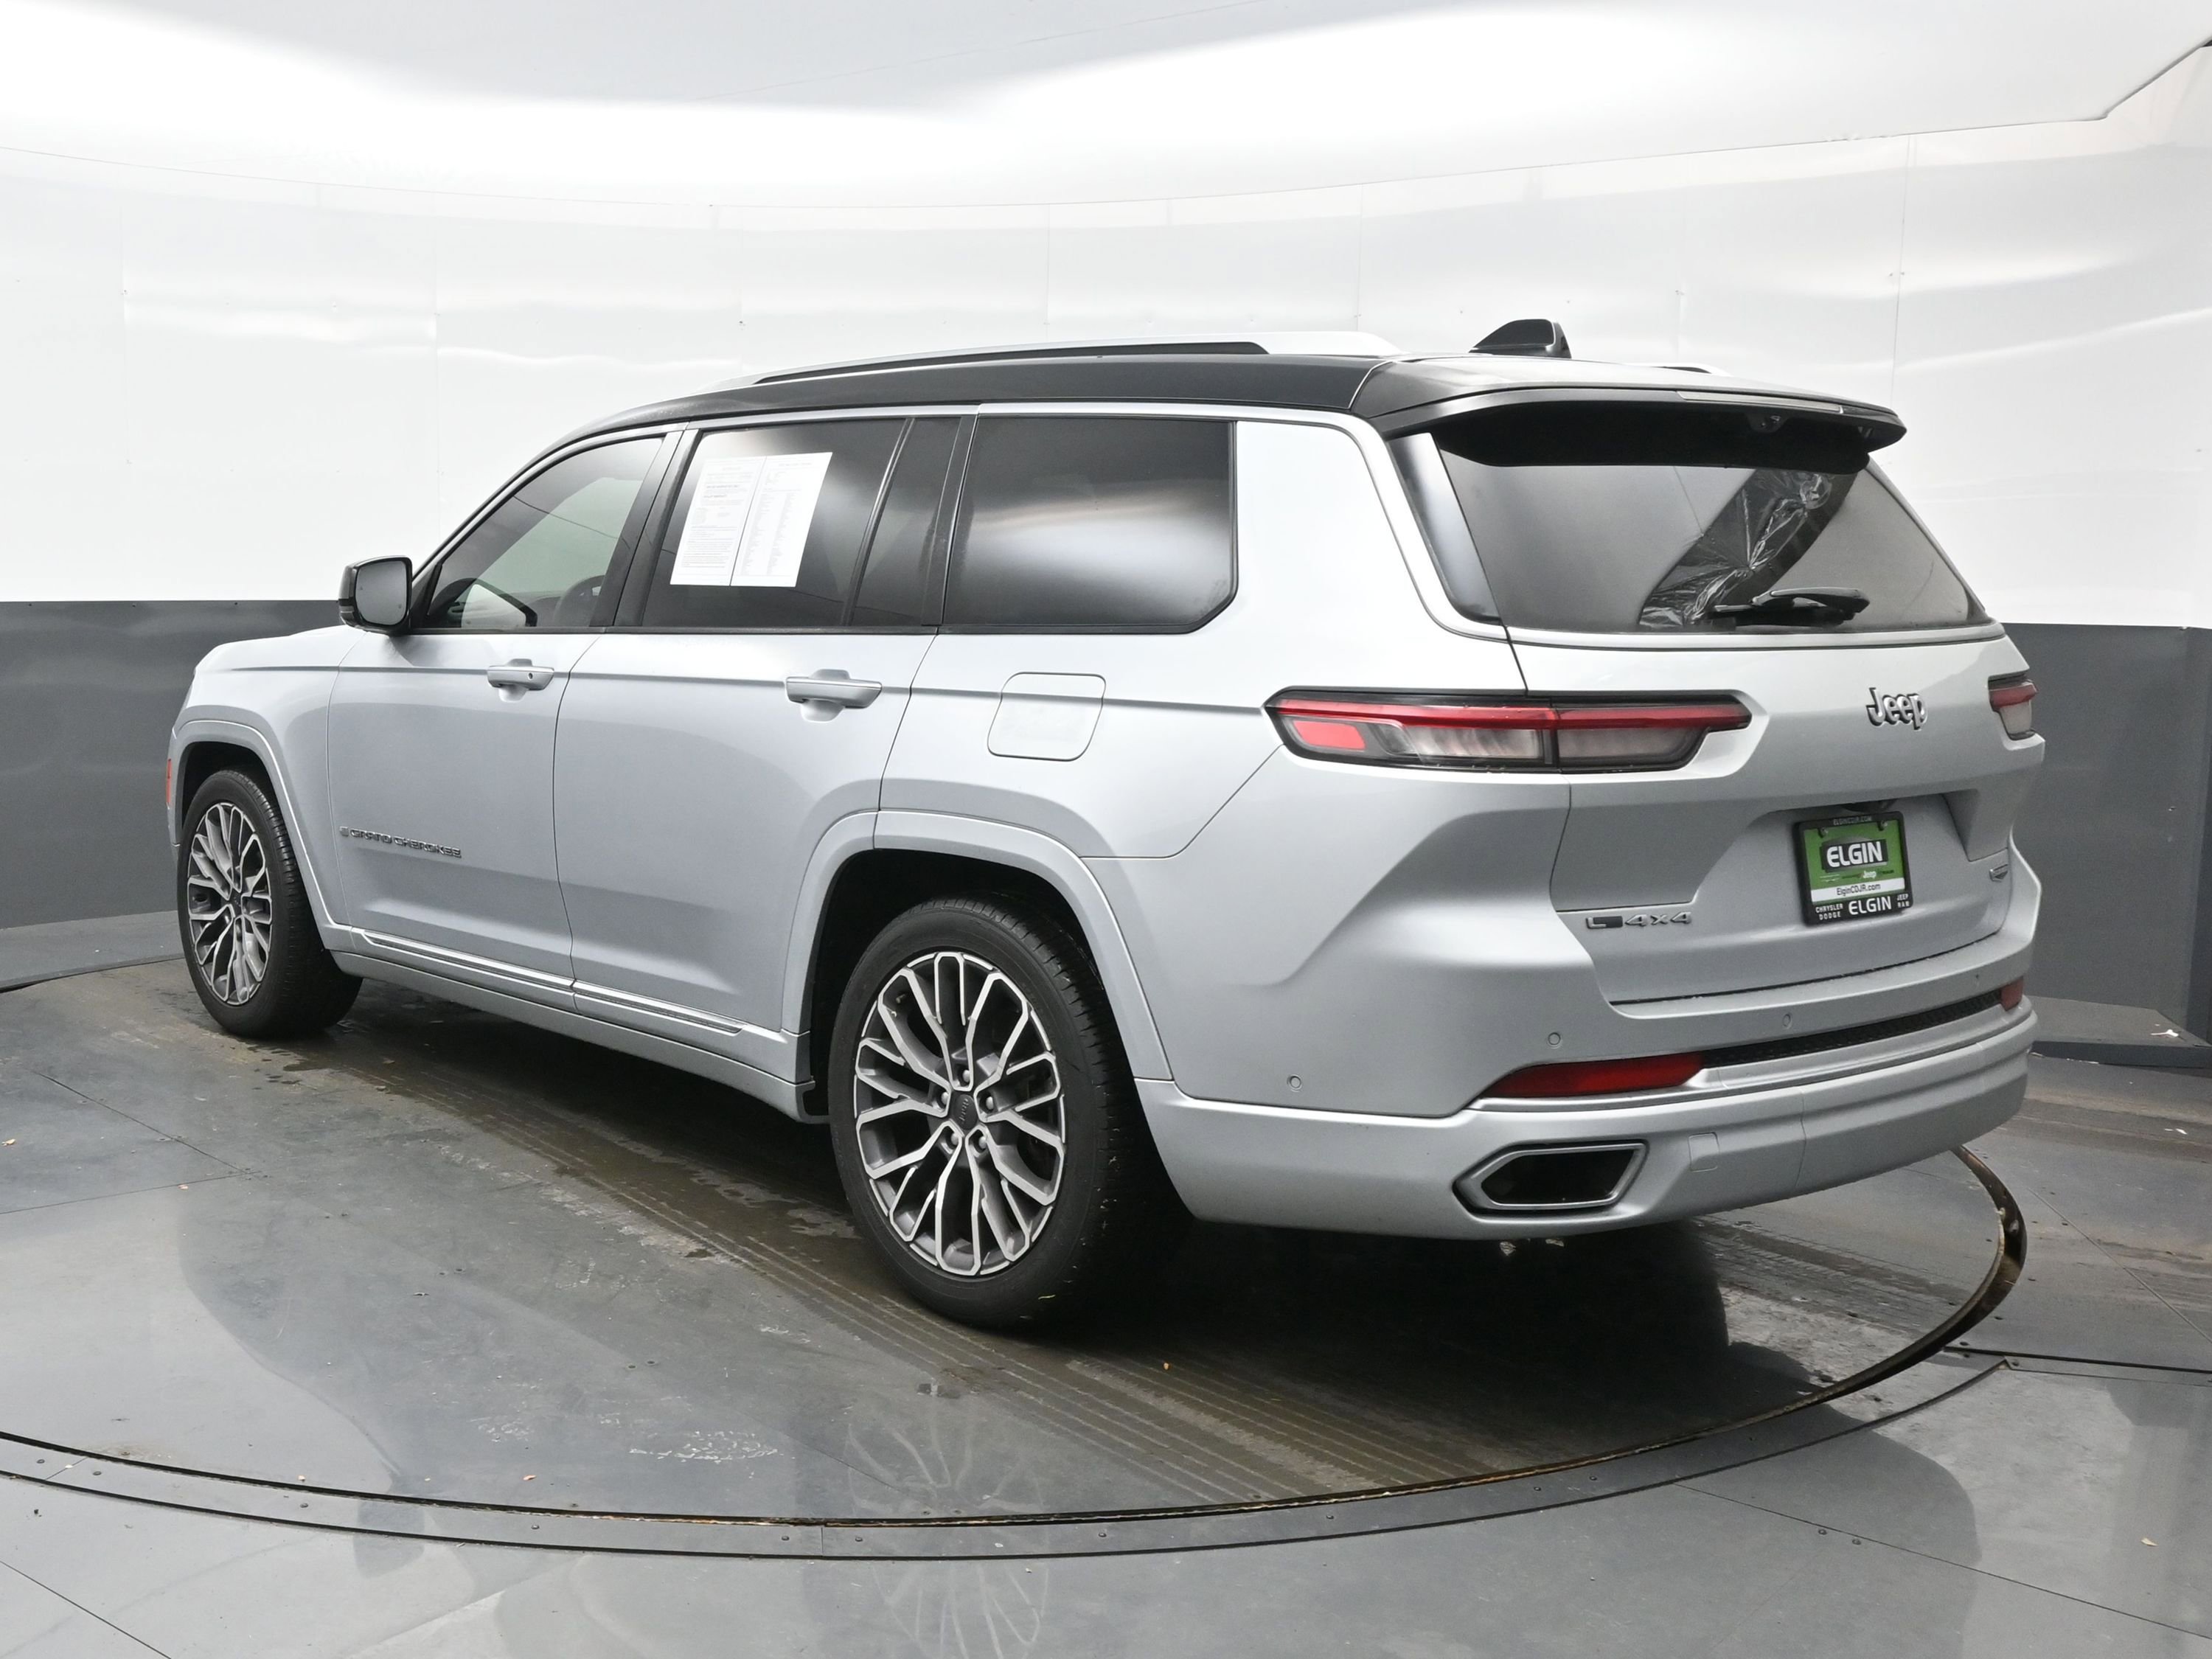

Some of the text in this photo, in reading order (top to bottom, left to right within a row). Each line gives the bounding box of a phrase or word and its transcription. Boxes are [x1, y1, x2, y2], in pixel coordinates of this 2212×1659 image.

[1865, 686, 1928, 731] Jeep
[350, 828, 392, 844] GRAND
[393, 835, 462, 858] CHEROKEE
[1826, 841, 1883, 868] ELGIN
[1863, 870, 1877, 879] Jeep
[1815, 903, 1843, 914] CHRYSLER
[1848, 896, 1892, 915] ELGIN
[1819, 911, 1841, 920] DODGE
